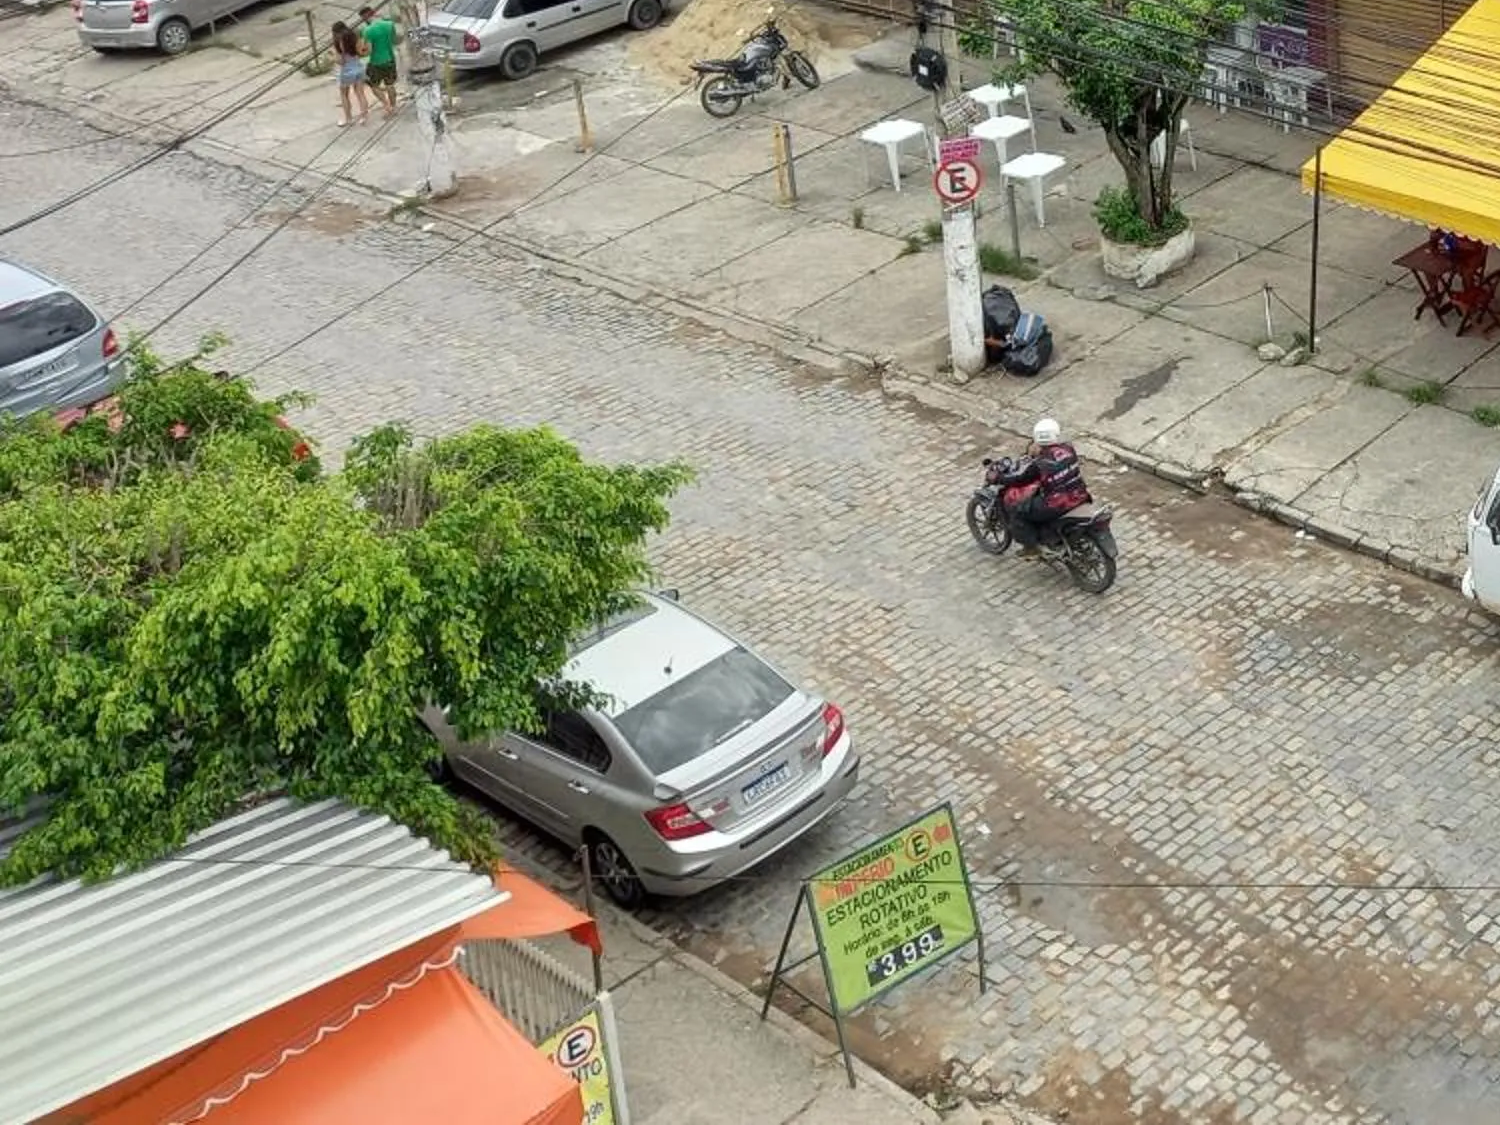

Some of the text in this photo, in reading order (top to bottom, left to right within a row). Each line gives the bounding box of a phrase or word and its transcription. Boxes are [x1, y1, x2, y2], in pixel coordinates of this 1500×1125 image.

[950, 167, 966, 193] E
[912, 834, 926, 857] E
[826, 850, 953, 926] ESTACIONAMENTO
[860, 885, 927, 929] ROTATIVO
[566, 1031, 587, 1061] E
